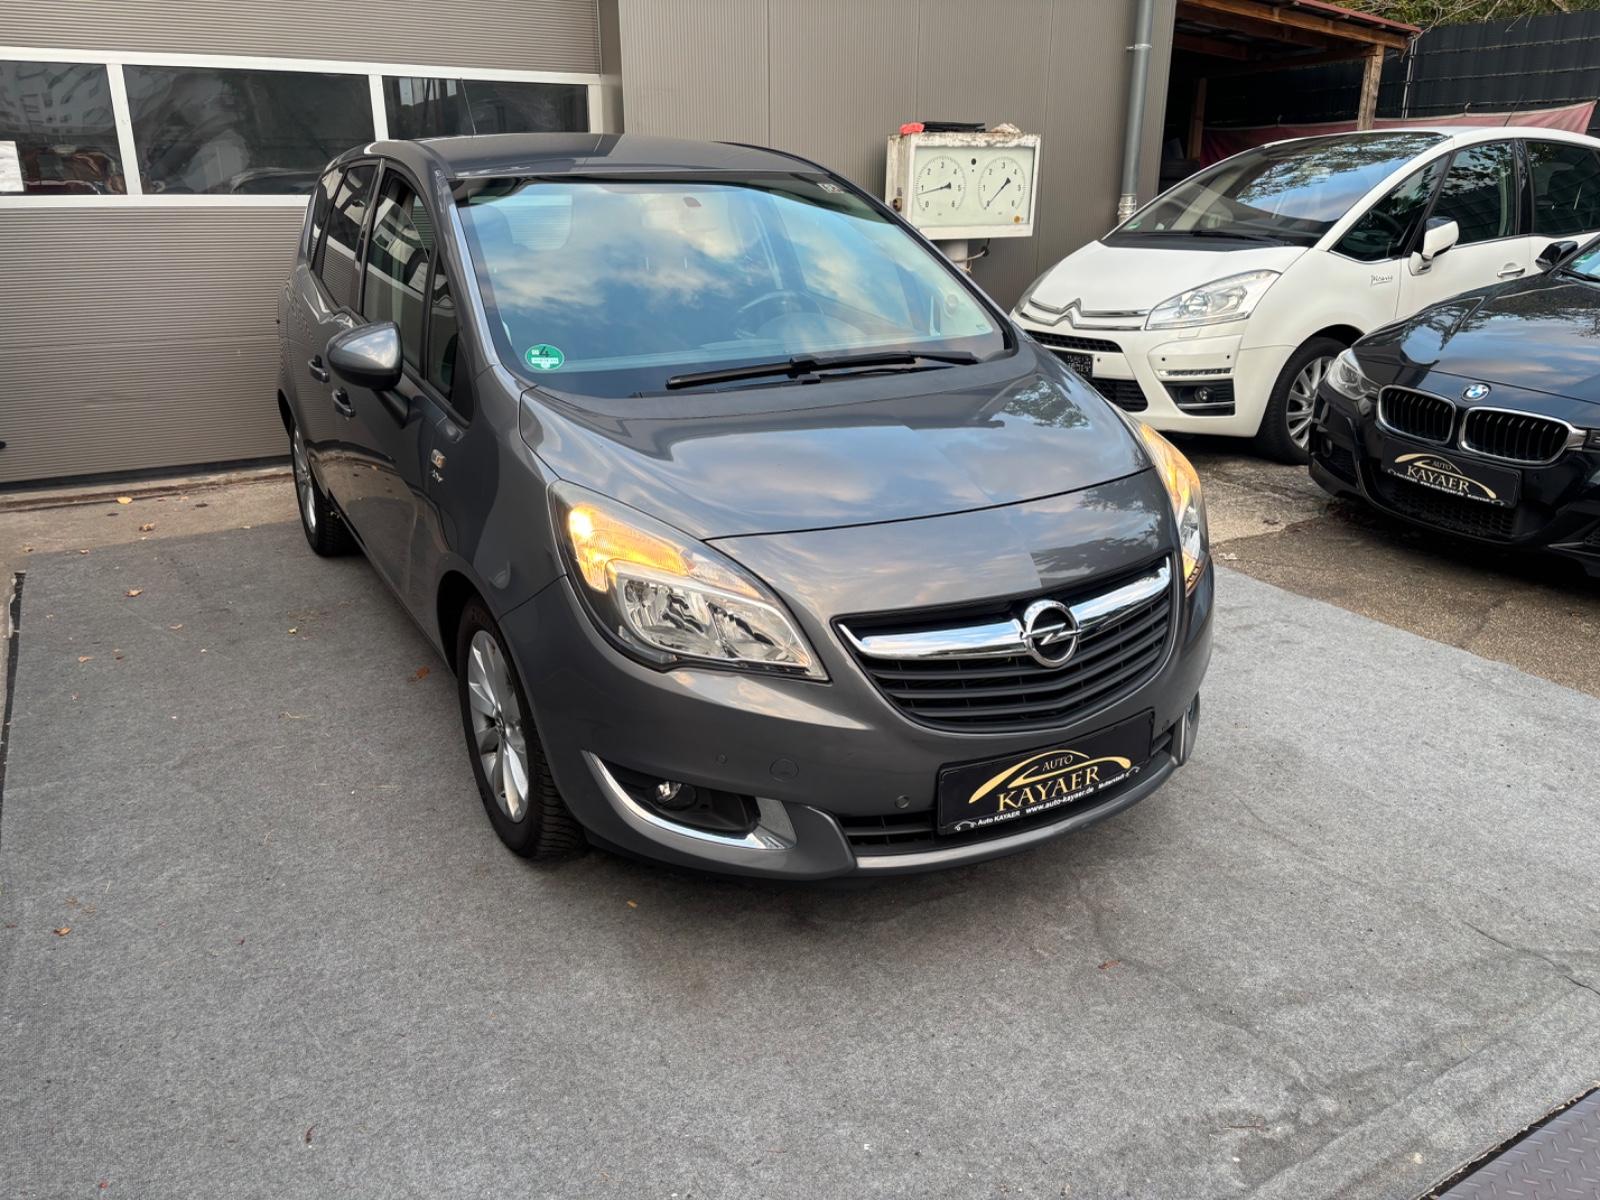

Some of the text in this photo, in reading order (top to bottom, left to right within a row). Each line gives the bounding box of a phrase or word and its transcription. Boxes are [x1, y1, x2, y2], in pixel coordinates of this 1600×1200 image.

[539, 346, 550, 358] 4
[1432, 460, 1452, 470] AUTO
[1407, 465, 1470, 492] KAYAER
[1042, 754, 1073, 772] AUTO
[997, 766, 1100, 812] KAYAER
[977, 818, 994, 826] Auto
[994, 810, 1021, 822] KAYAER
[1025, 786, 1094, 814] www.auto-kayaer.de
